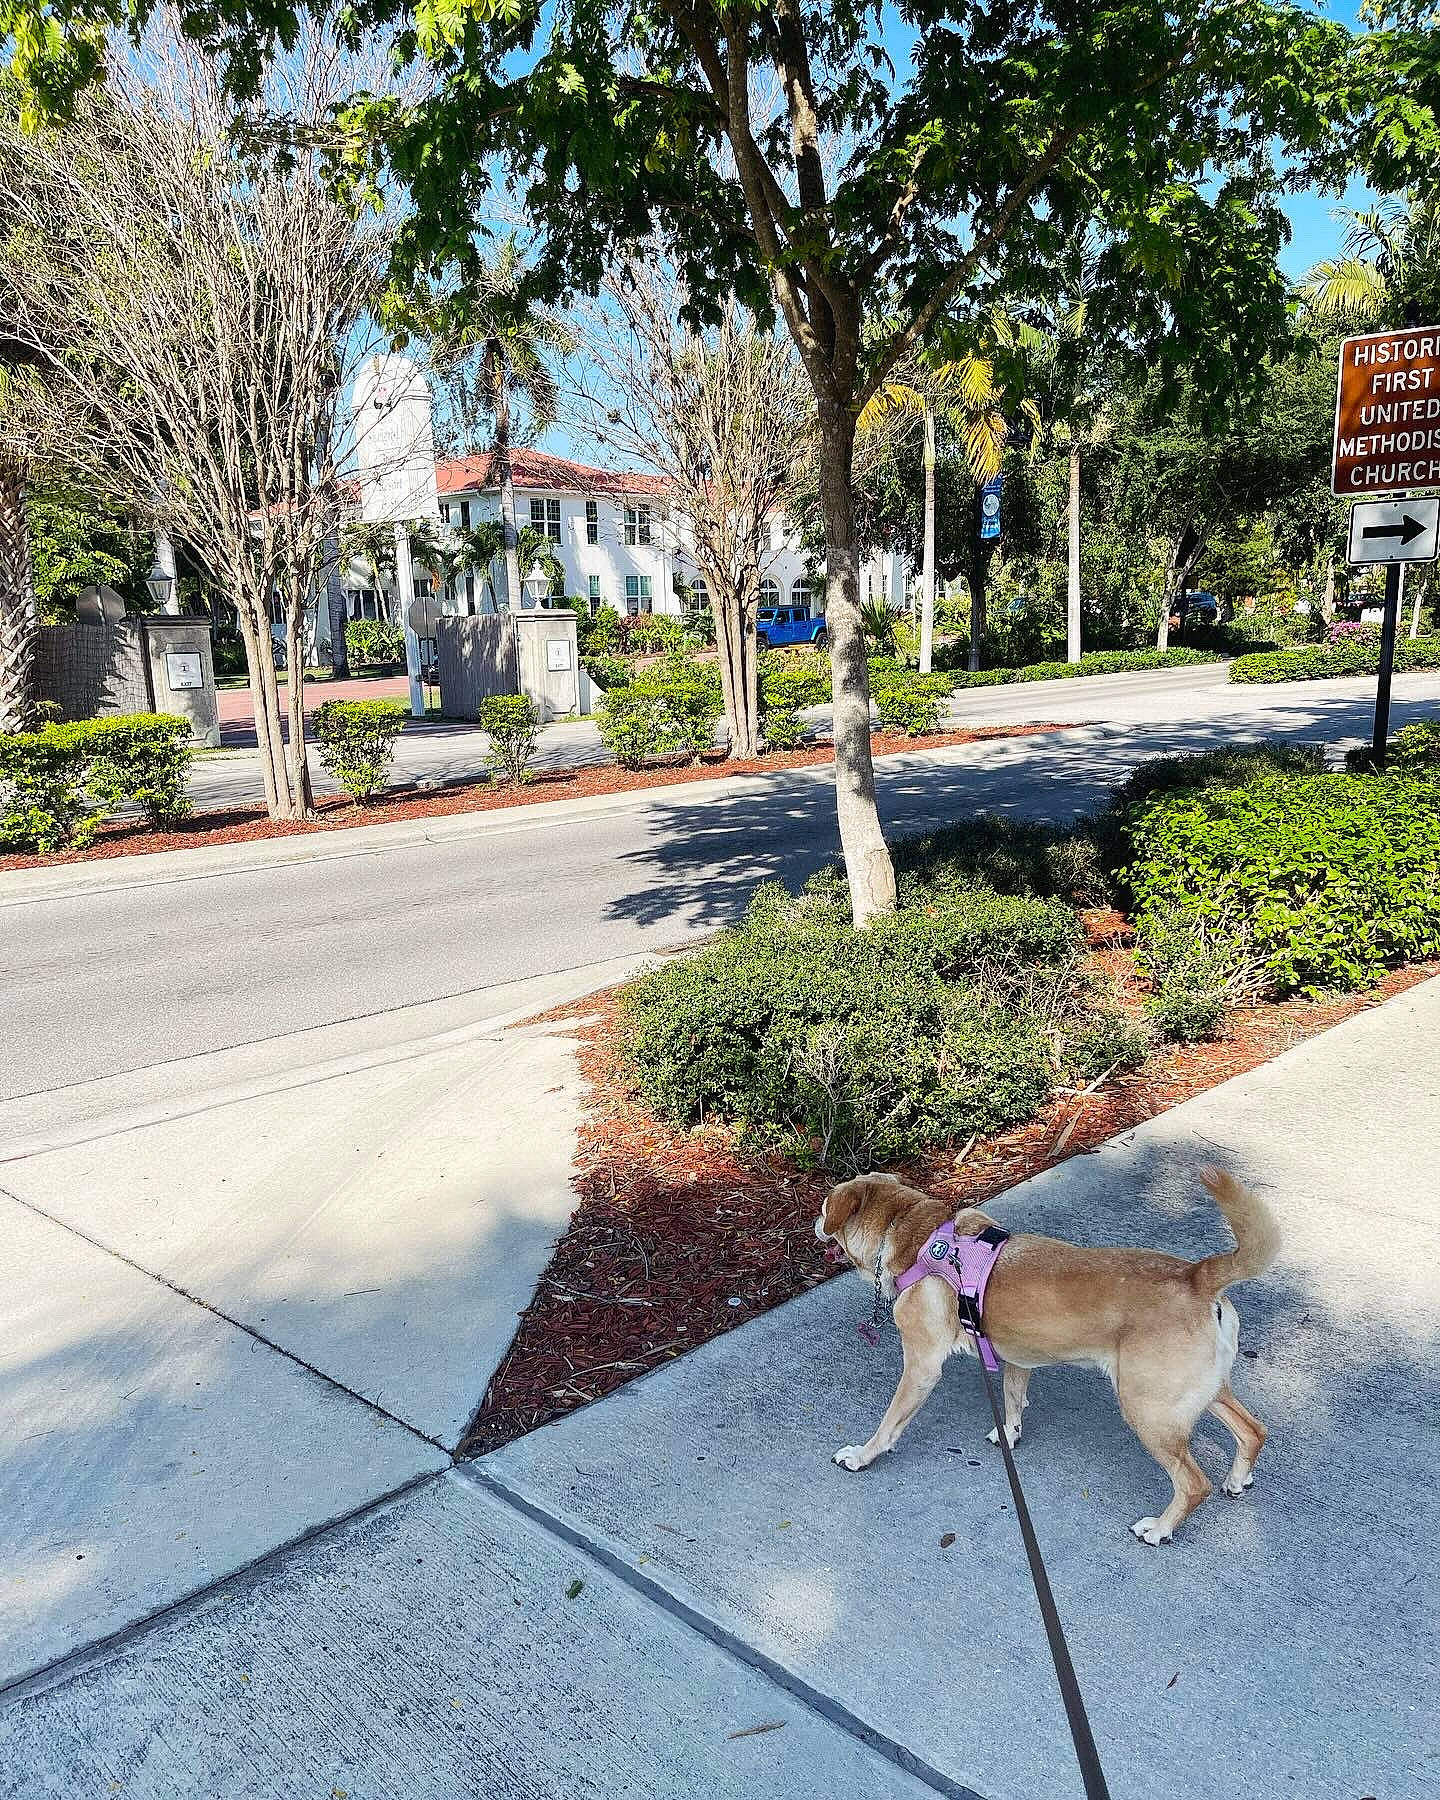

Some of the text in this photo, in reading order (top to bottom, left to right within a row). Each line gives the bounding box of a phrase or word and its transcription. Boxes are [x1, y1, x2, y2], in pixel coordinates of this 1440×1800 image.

[1372, 368, 1434, 394] FIRST
[1360, 399, 1440, 425] UNITED
[1351, 460, 1440, 485] CHURCH
